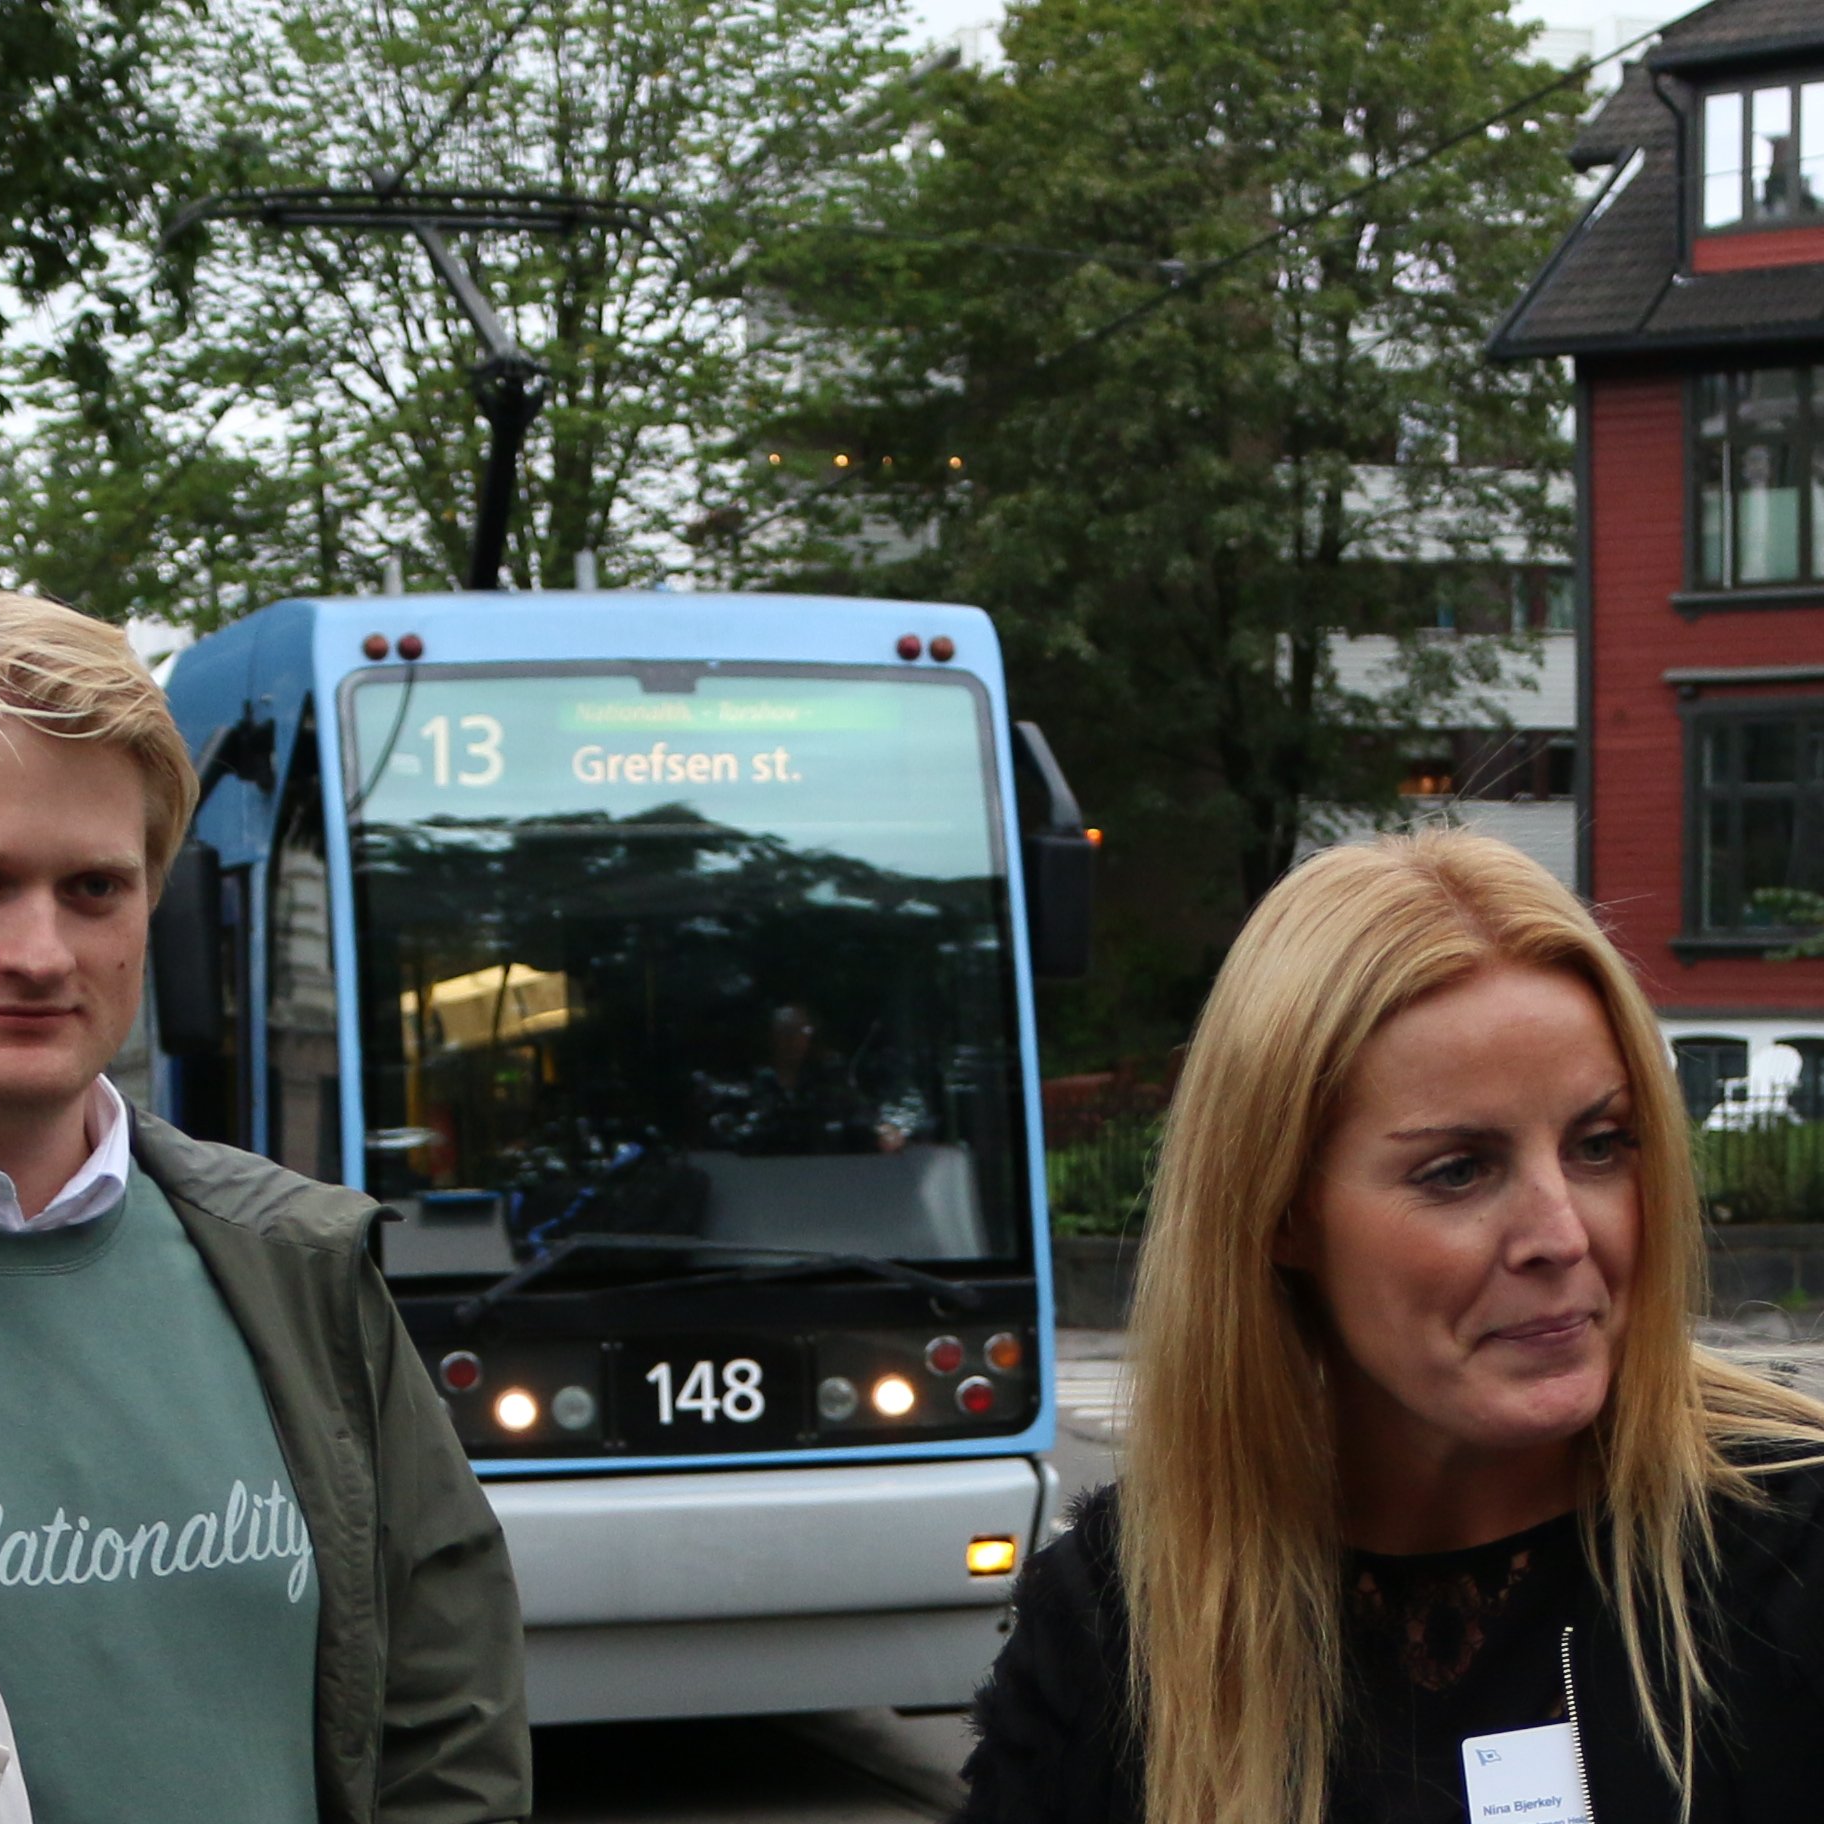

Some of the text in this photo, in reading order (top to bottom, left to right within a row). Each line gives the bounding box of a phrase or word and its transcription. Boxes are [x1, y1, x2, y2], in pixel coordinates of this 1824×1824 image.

[421, 713, 505, 788] 13
[572, 740, 803, 784] Grefsen st.
[645, 1358, 766, 1424] 148
[1483, 1803, 1511, 1816] Nina
